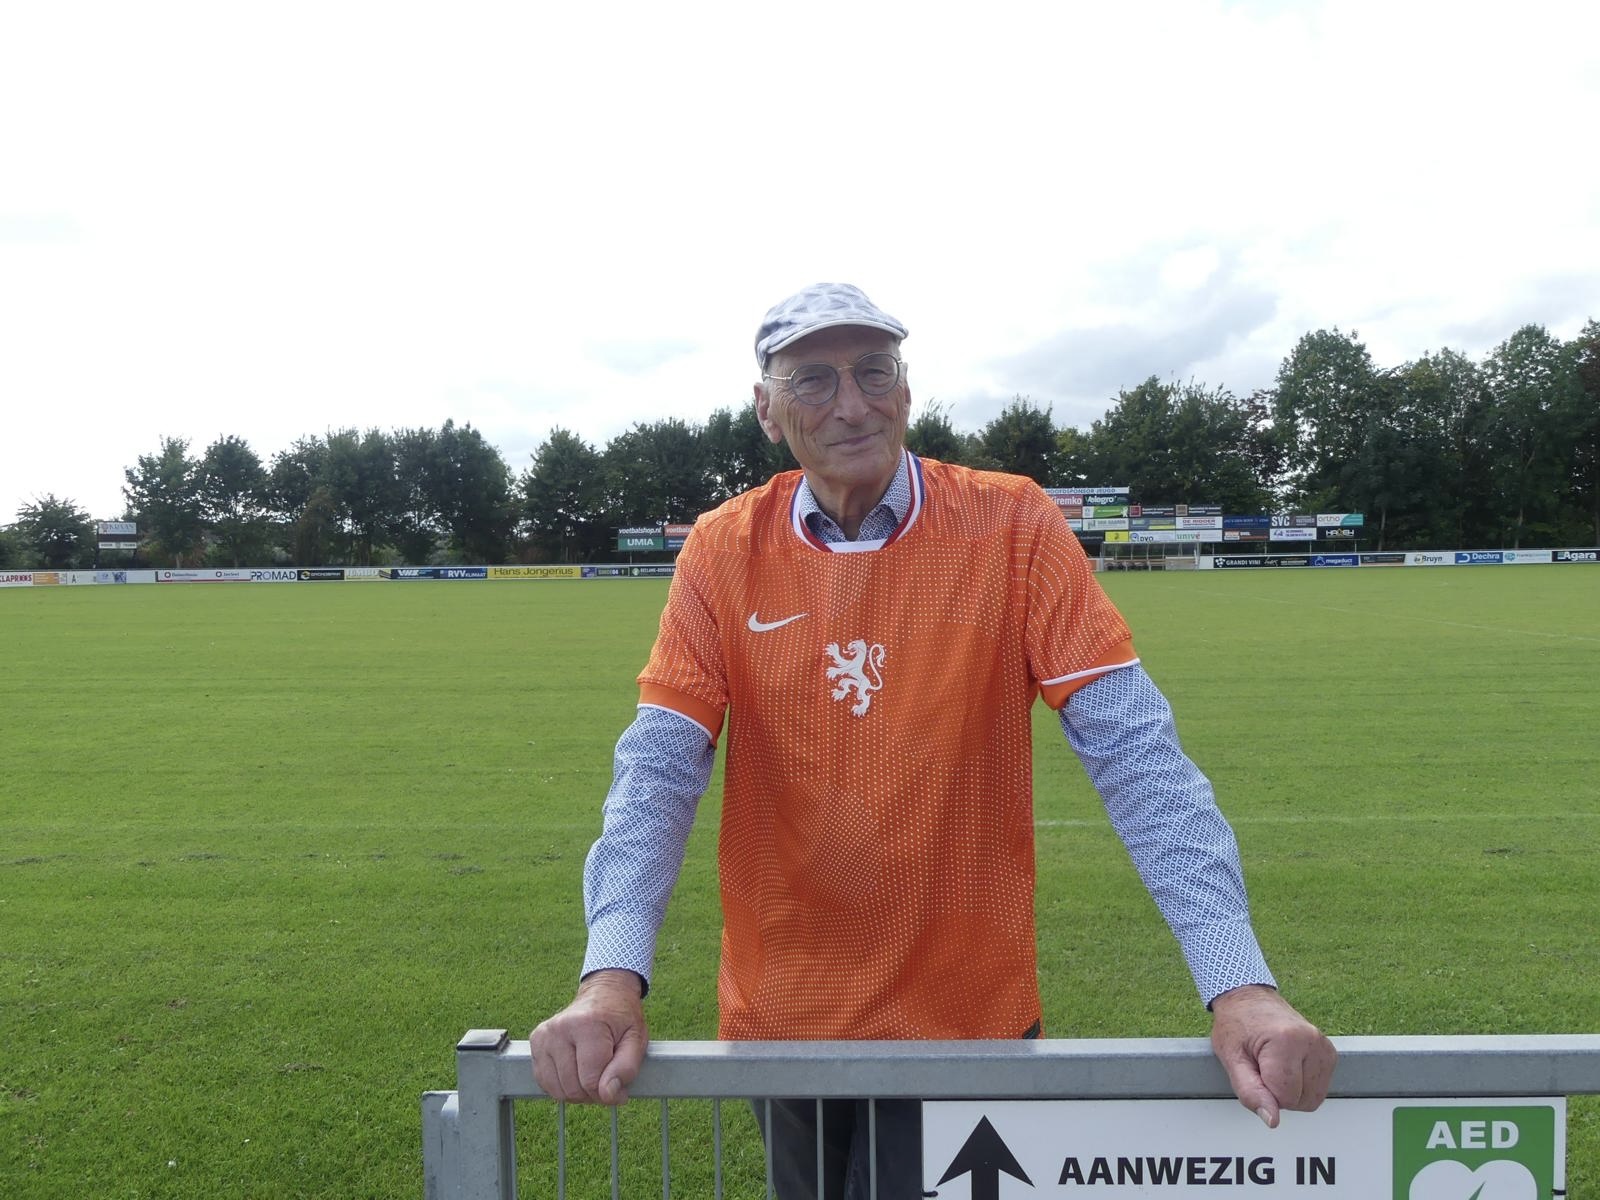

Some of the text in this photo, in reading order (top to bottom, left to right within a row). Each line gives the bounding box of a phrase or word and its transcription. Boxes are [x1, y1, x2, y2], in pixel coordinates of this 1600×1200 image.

[1271, 515, 1290, 527] SVC
[627, 538, 654, 546] UMIA
[1472, 552, 1500, 560] Dechra
[251, 571, 296, 580] PROMAD
[447, 570, 466, 578] RVV
[494, 567, 521, 575] Hans
[522, 567, 574, 577] Jongerius
[1426, 1120, 1520, 1149] AED
[1058, 1156, 1336, 1185] AANWEZIG IN
